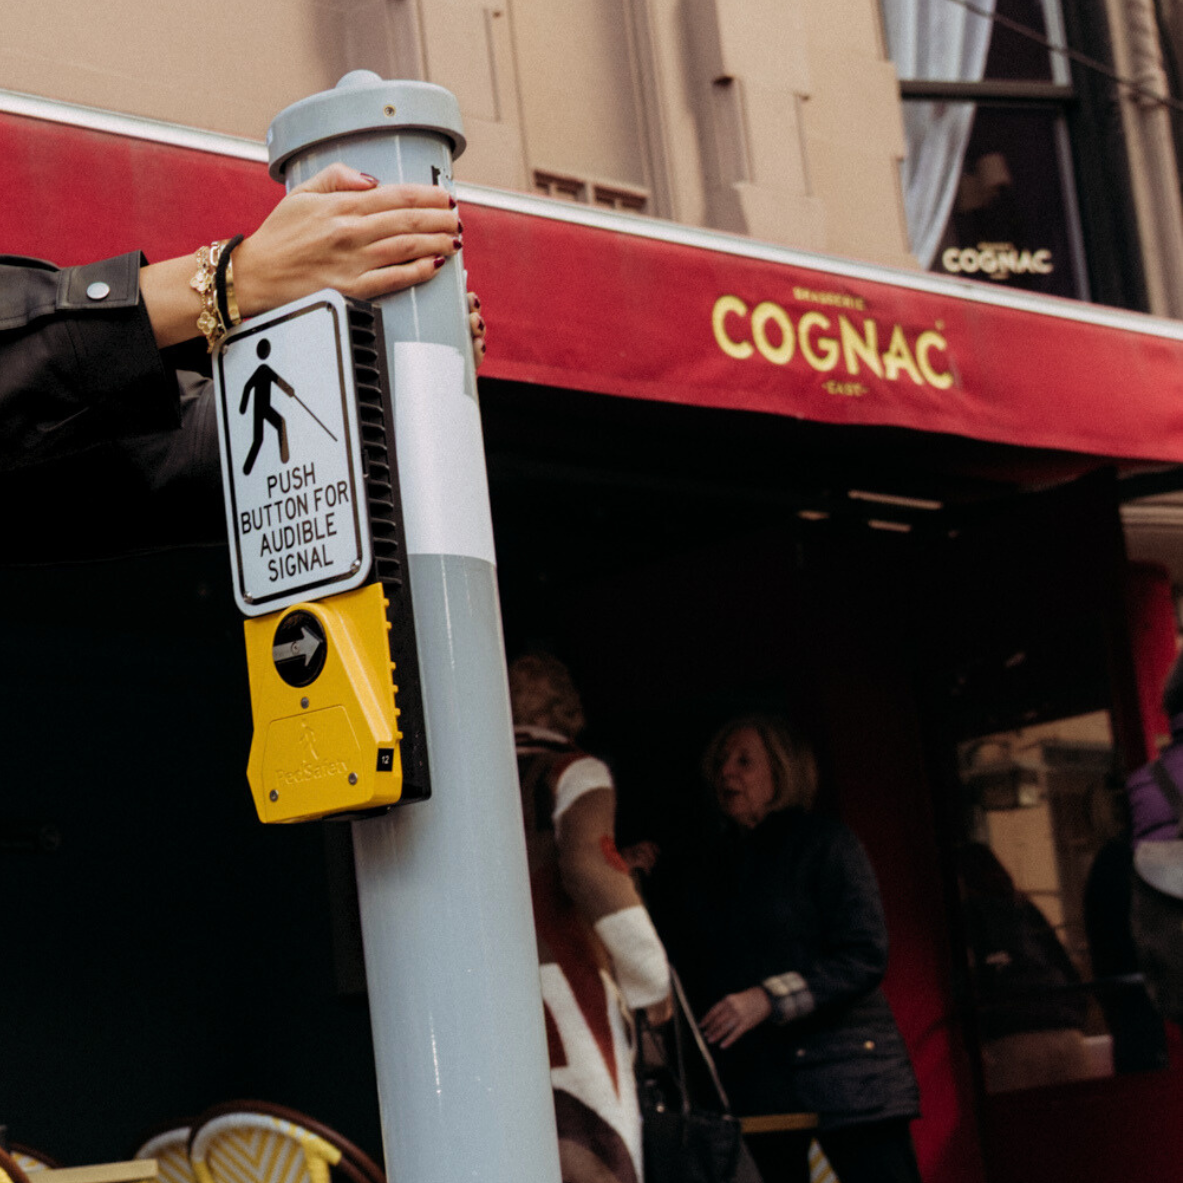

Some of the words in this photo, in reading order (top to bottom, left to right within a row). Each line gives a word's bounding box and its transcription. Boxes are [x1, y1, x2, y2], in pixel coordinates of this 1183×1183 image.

[942, 247, 1055, 275] COGNAC
[711, 294, 955, 390] COGNAC
[266, 461, 317, 499] PUSH
[240, 492, 310, 535] BUTTON
[313, 480, 350, 513] FOR
[259, 512, 338, 558] AUDIBLE
[268, 543, 334, 583] SIGNAL
